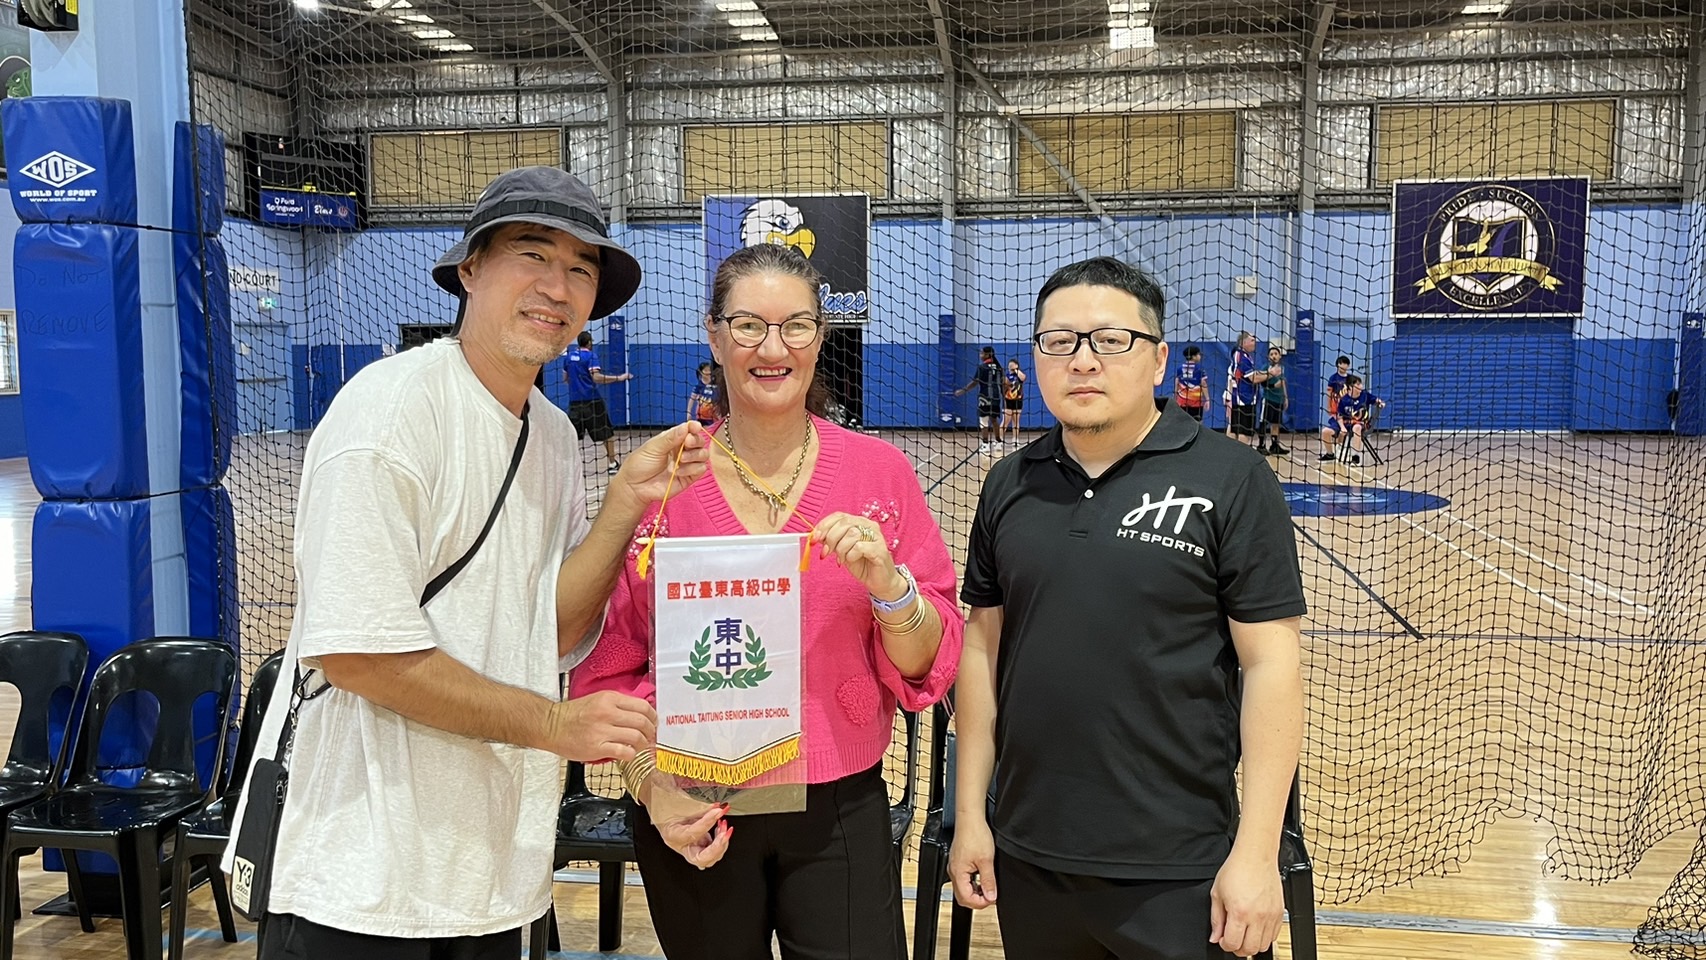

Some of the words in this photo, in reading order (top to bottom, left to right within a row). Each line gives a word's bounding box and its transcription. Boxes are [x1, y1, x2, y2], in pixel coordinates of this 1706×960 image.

[31, 156, 78, 182] WOS
[20, 190, 52, 198] WORLD
[54, 189, 66, 197] OF
[67, 189, 98, 197] SPORT
[1439, 192, 1477, 223] PRIDE
[1488, 189, 1540, 221] SUCCESS
[229, 270, 243, 284] ND
[245, 273, 277, 287] COURT
[1449, 284, 1525, 306] EXCELLENCE
[1116, 528, 1139, 539] HT
[1139, 531, 1205, 558] SPORTS
[667, 577, 791, 600] 國立臺東高級中學
[714, 617, 742, 675] 東中
[666, 713, 697, 726] NATIONAL
[698, 711, 724, 723] TAITUNG
[724, 709, 748, 721] SENIOR
[749, 708, 764, 719] HIGH
[764, 707, 790, 718] SCHOOL
